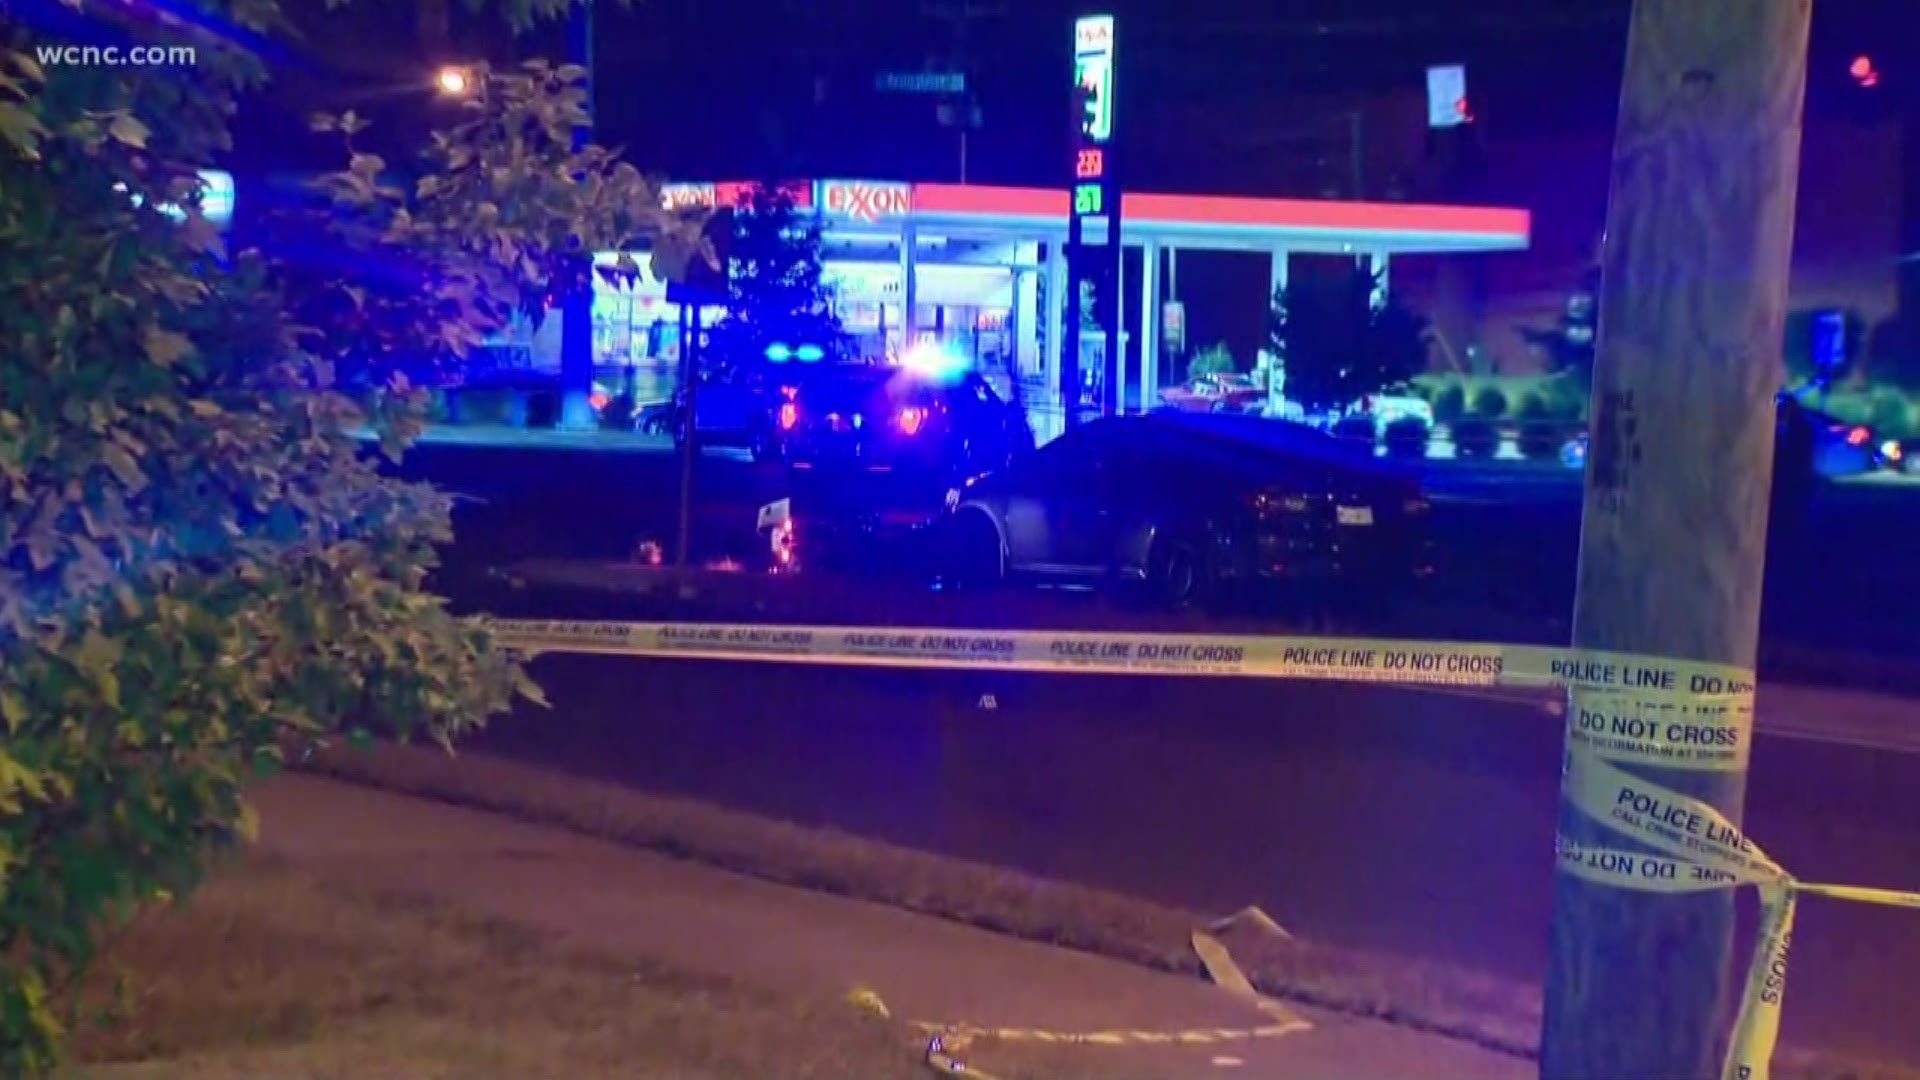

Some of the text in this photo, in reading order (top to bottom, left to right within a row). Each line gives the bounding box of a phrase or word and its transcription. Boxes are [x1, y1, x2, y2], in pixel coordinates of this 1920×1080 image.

[828, 184, 910, 222] EXXON
[1051, 640, 1244, 662] POLICE LINE DO NOT CROSS
[1284, 648, 1503, 674] POLICE LINE DO NOT CROSS
[1551, 659, 1616, 684] POLICE
[1623, 667, 1676, 690] LINE
[1690, 674, 1722, 694] DO
[1579, 708, 1605, 732] DO
[1612, 715, 1660, 740] NOT
[1666, 723, 1739, 746] CROSS
[1618, 787, 1754, 854] POLICE LINE
[1587, 852, 1634, 875] NOT
[1641, 859, 1676, 880] DO
